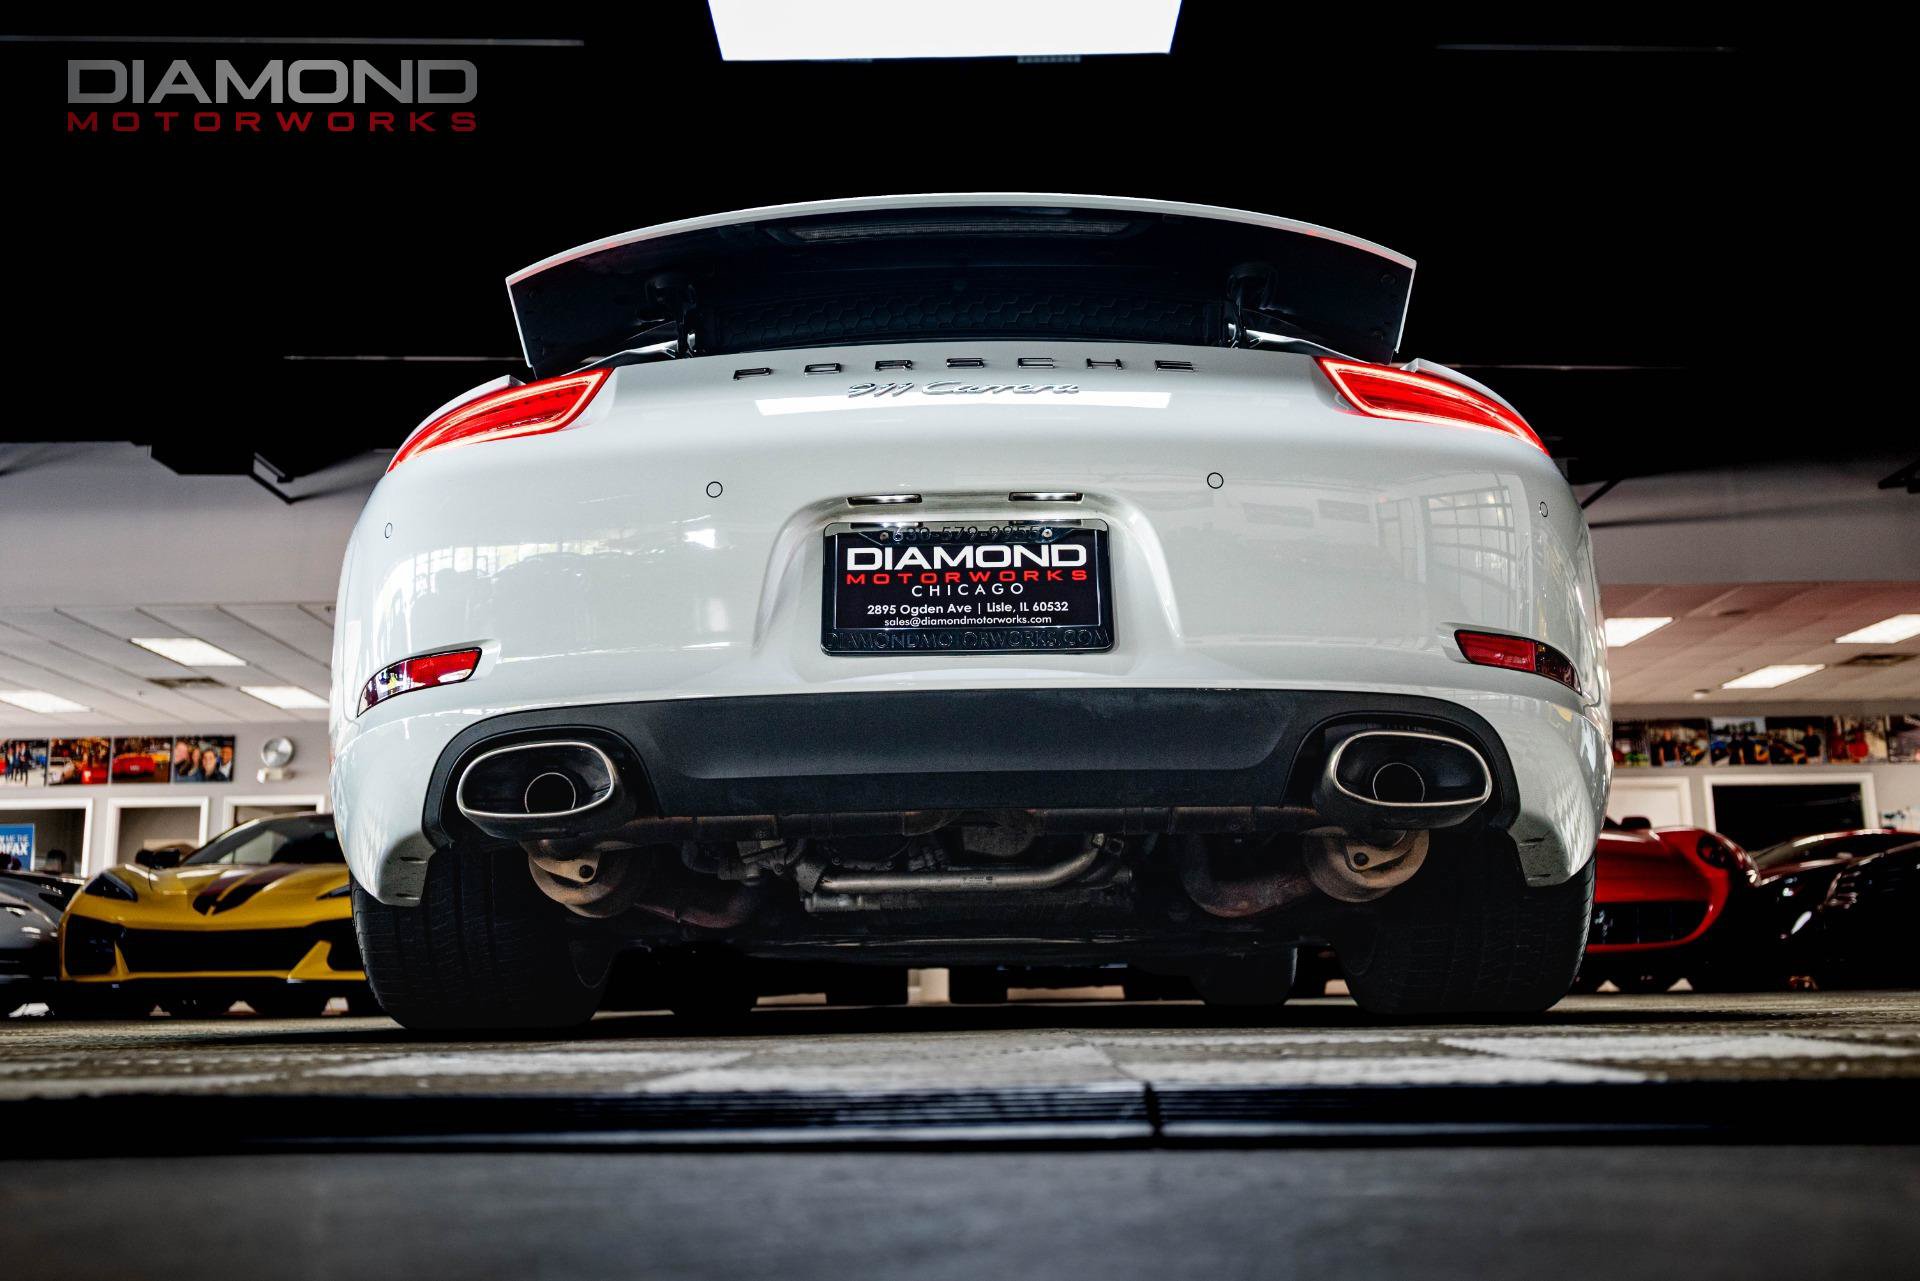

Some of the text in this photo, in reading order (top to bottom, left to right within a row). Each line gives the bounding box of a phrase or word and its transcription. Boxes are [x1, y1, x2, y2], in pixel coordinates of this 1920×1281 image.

[732, 356, 1195, 381] PORSCHE
[847, 380, 1080, 398] 911 Carrera
[846, 544, 1087, 571] DIAMOND
[846, 569, 1088, 585] MOTORWORKS
[911, 583, 1024, 597] CHICAGO
[867, 604, 897, 615] 2895
[900, 603, 944, 617] Ogden
[947, 603, 972, 613] Ave
[987, 602, 1016, 613] Lisle,
[1020, 602, 1029, 612] IL
[1032, 601, 1069, 612] 60532
[884, 614, 1052, 627] sales@diamondmotorworks.com
[825, 629, 1110, 649] DIAMONDMOORWORKS.COM
